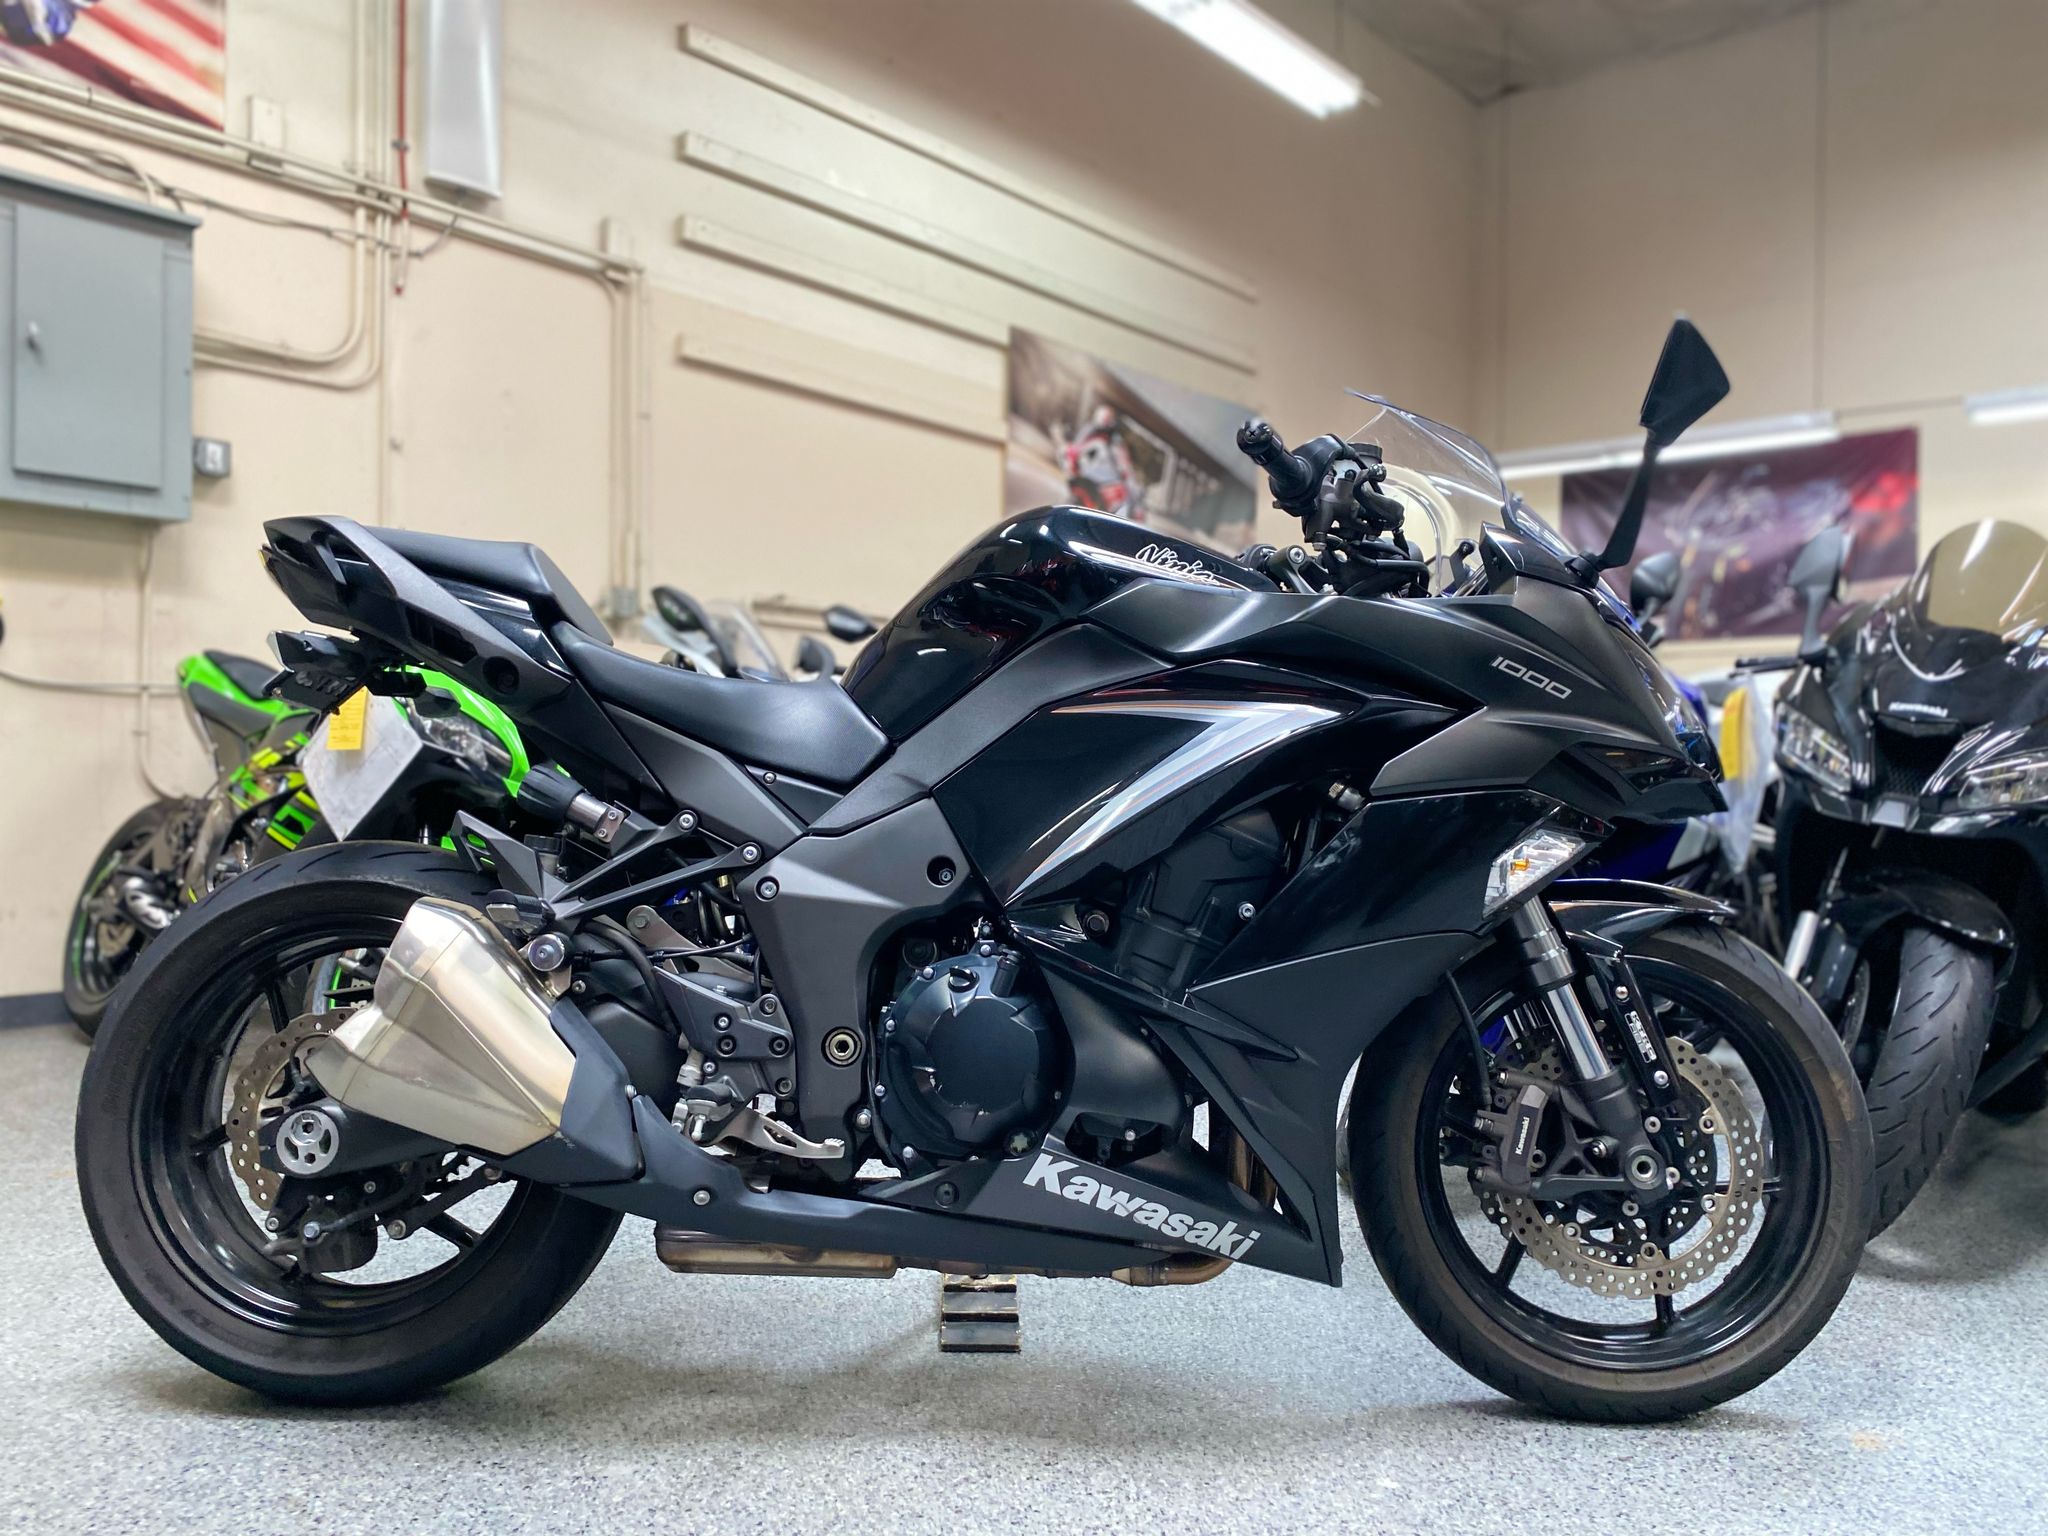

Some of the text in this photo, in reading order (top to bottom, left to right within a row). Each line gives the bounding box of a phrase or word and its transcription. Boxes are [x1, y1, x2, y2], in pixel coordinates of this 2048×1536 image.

[1135, 543, 1220, 586] Ninja
[1490, 656, 1572, 700] 1000
[1514, 1116, 1530, 1155] Kawasaki
[1022, 1152, 1262, 1260] Kawasaki
